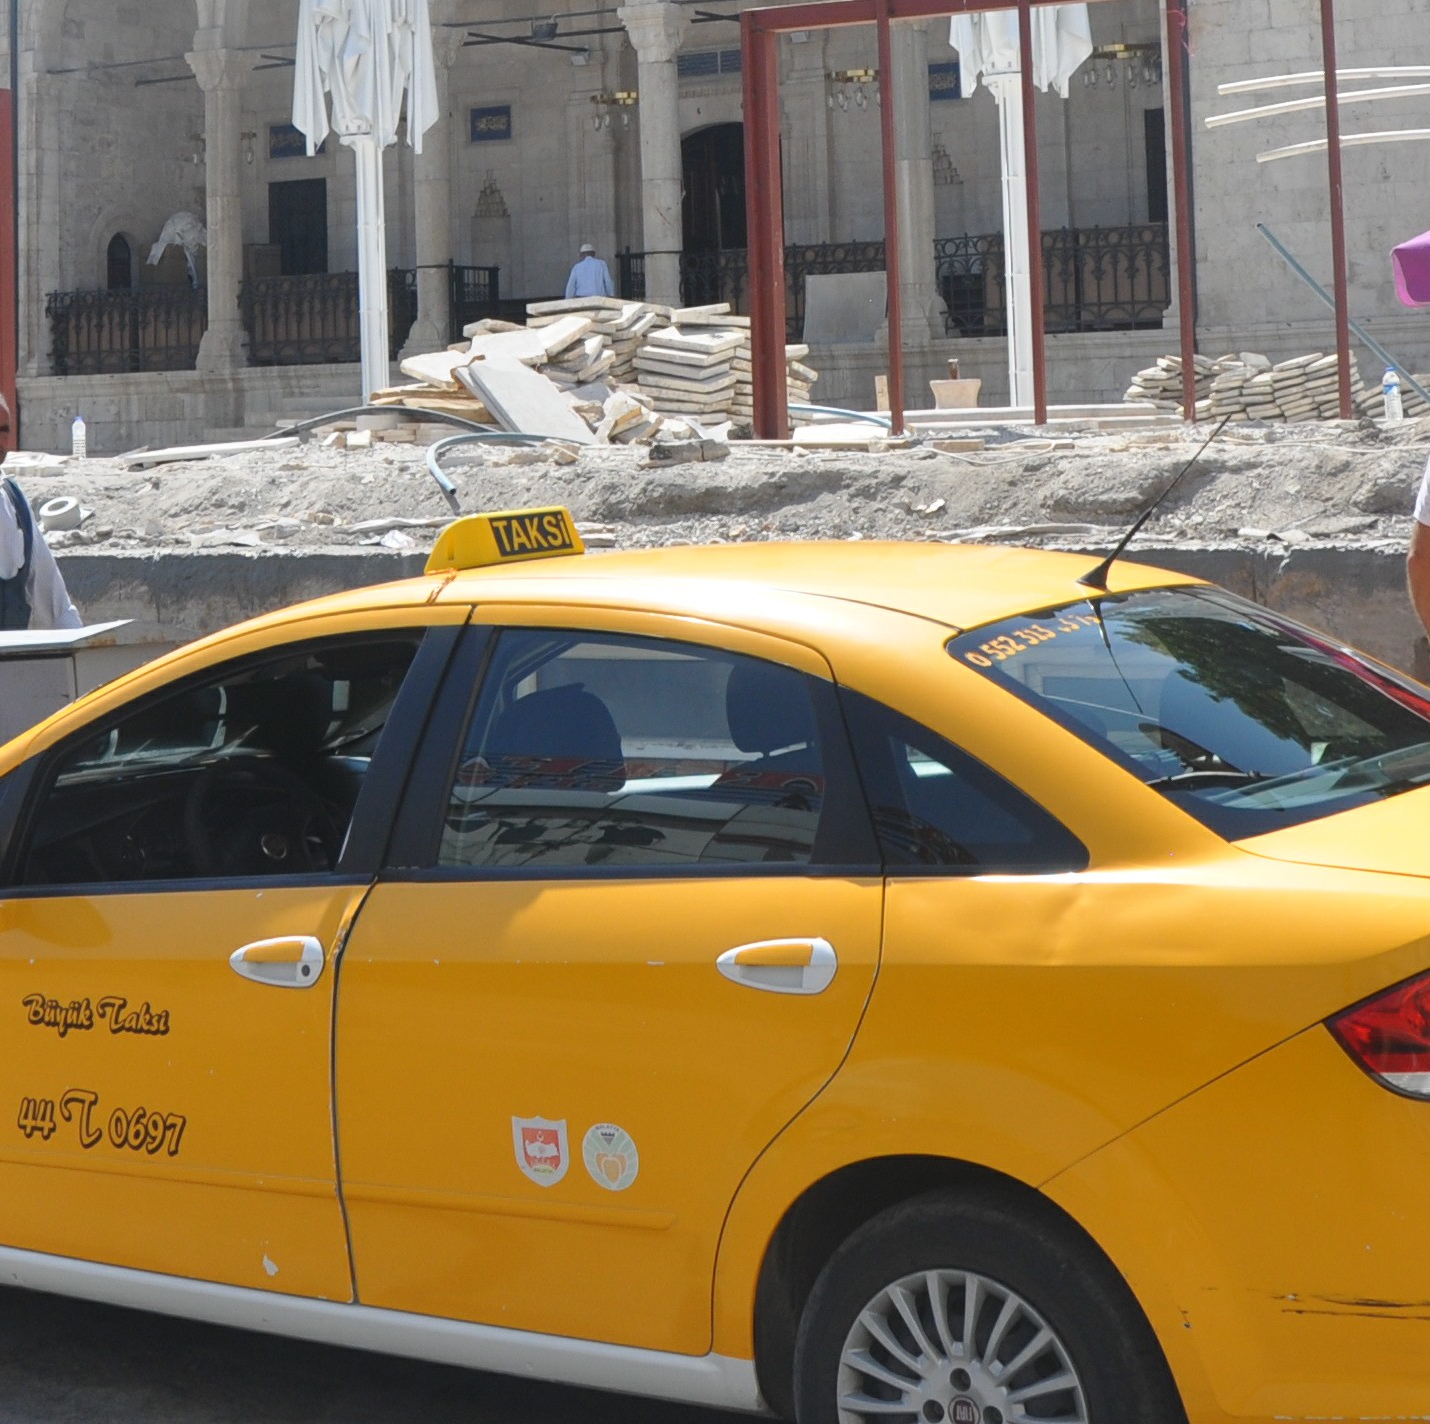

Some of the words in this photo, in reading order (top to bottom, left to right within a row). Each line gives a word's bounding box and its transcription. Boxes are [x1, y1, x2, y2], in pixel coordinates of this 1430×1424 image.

[22, 993, 94, 1038] Büyük
[96, 996, 170, 1036] Taksi
[18, 1097, 56, 1140] 44
[60, 1088, 102, 1149] T
[108, 1107, 186, 1157] 0697
